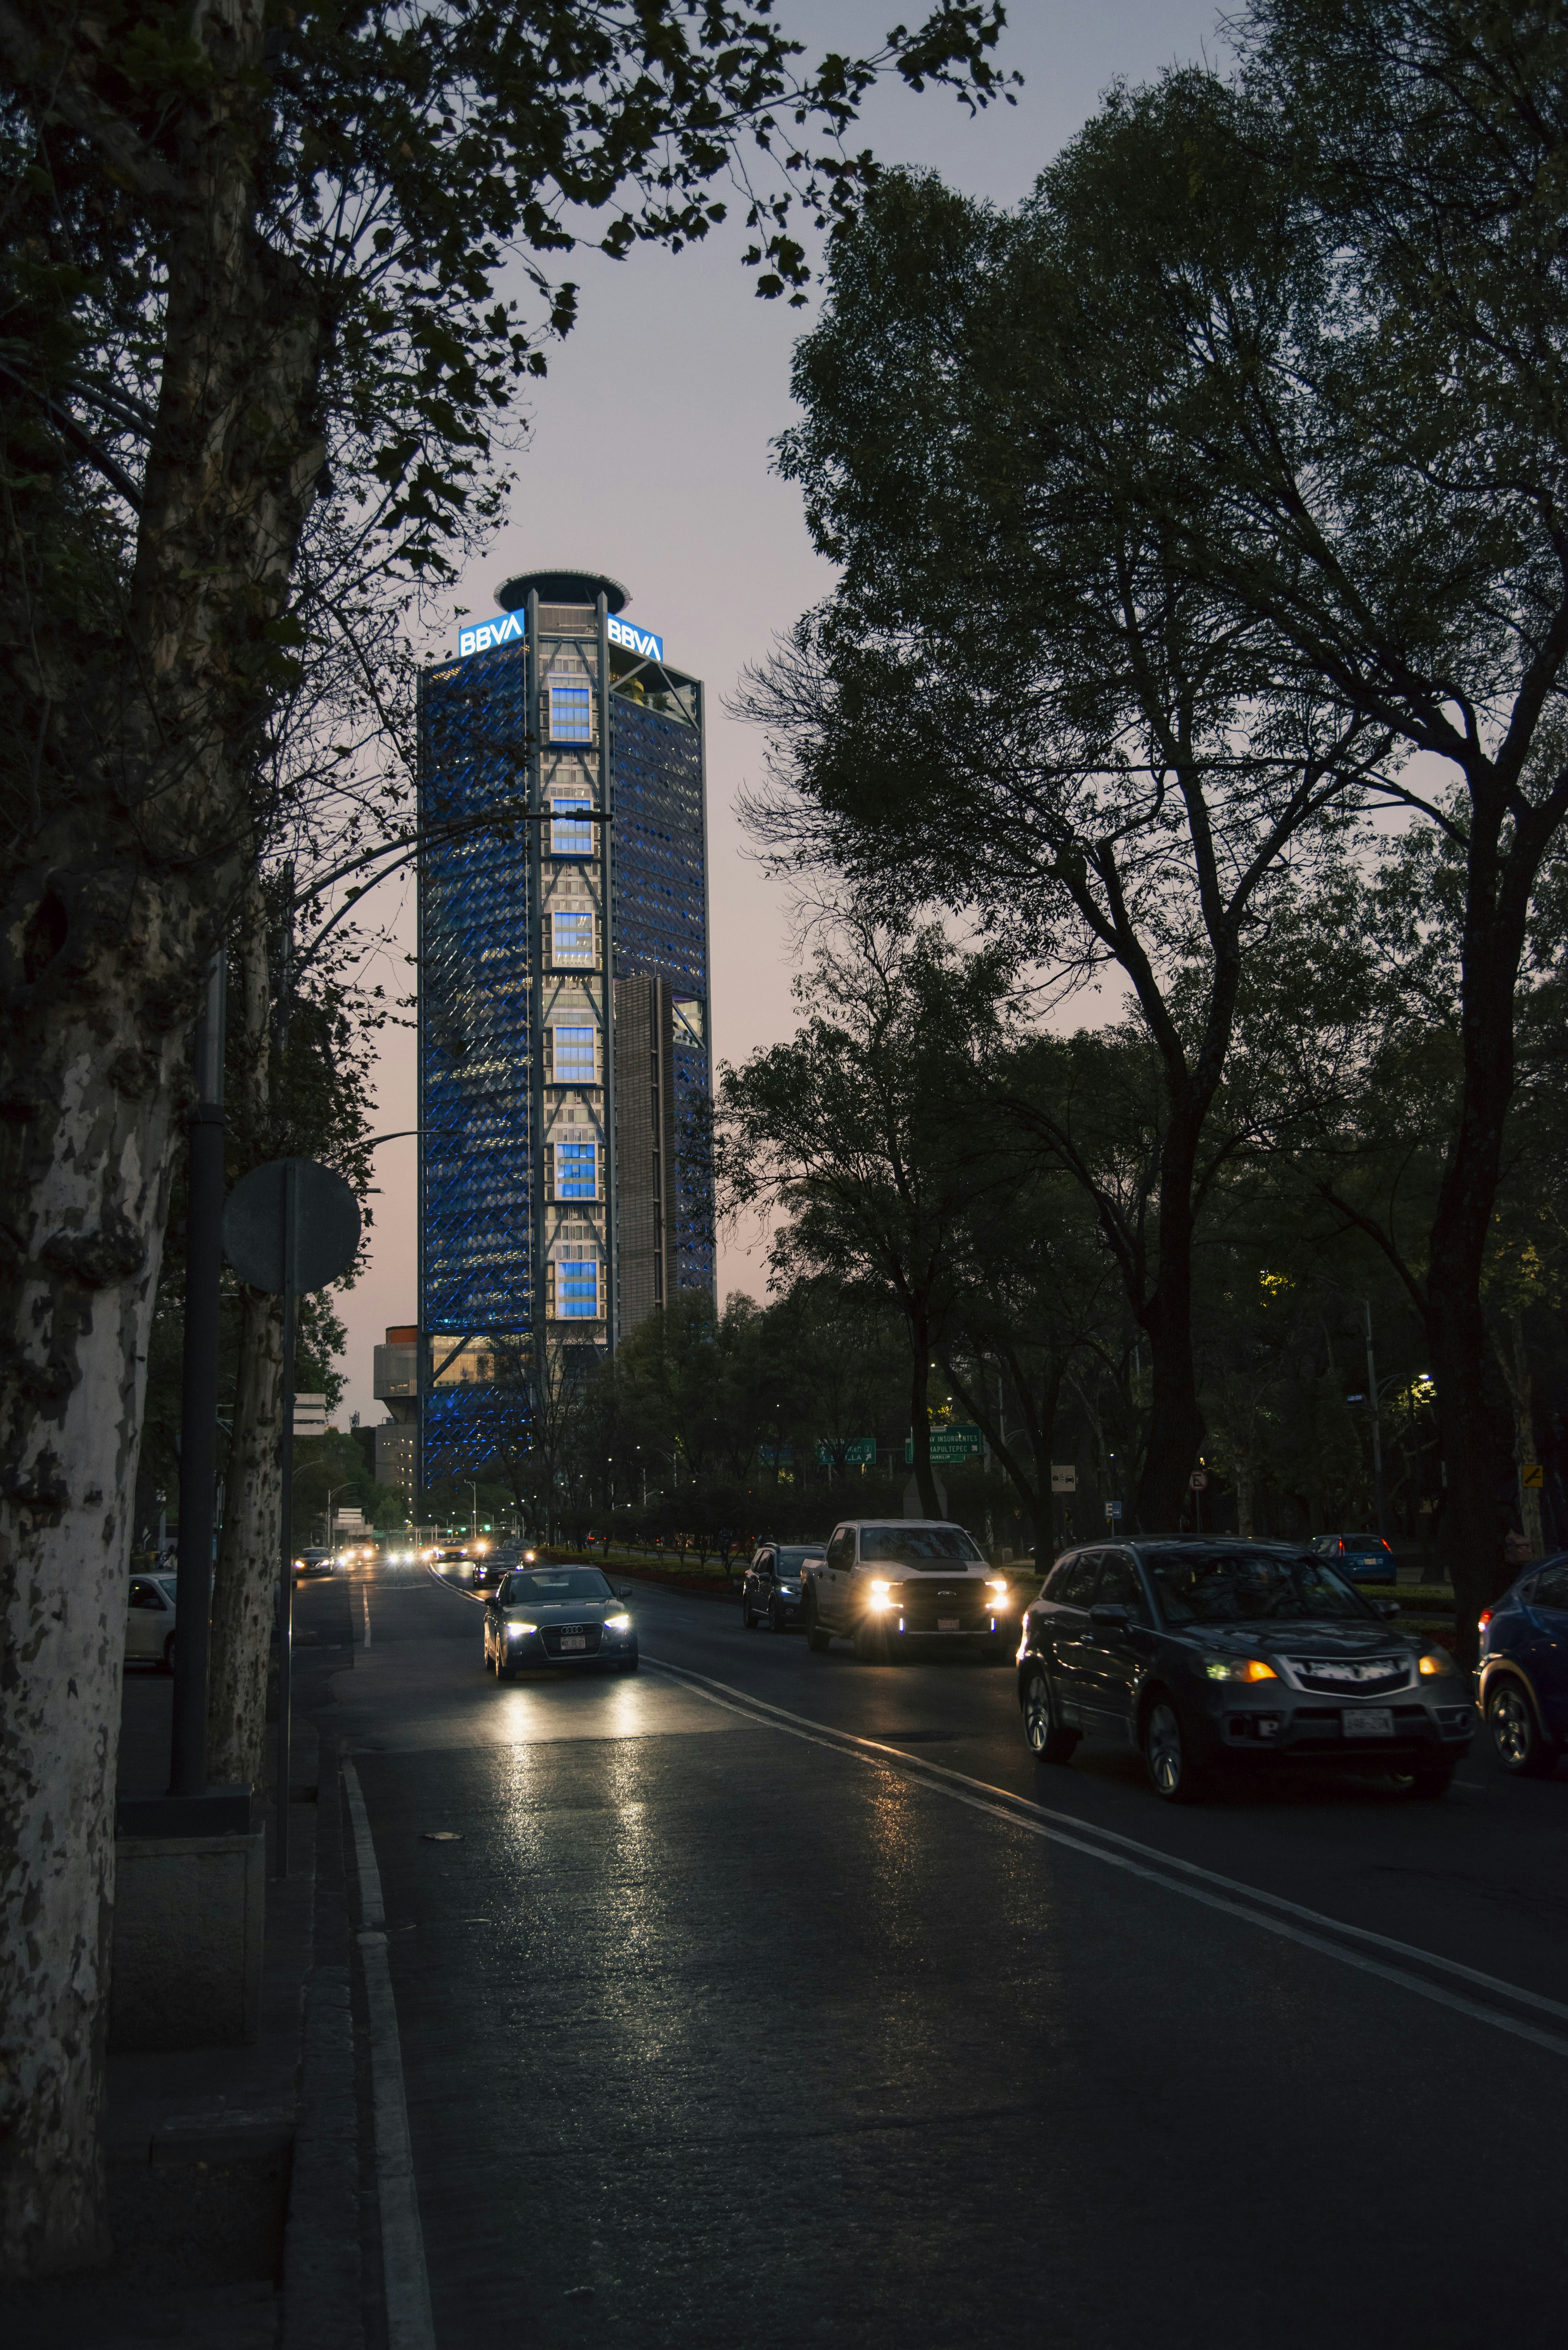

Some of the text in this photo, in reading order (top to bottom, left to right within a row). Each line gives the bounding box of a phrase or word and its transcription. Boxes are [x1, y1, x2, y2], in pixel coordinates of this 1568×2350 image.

[460, 615, 522, 657] BBVA
[608, 619, 661, 661] BBVA
[1106, 1503, 1113, 1516] E
